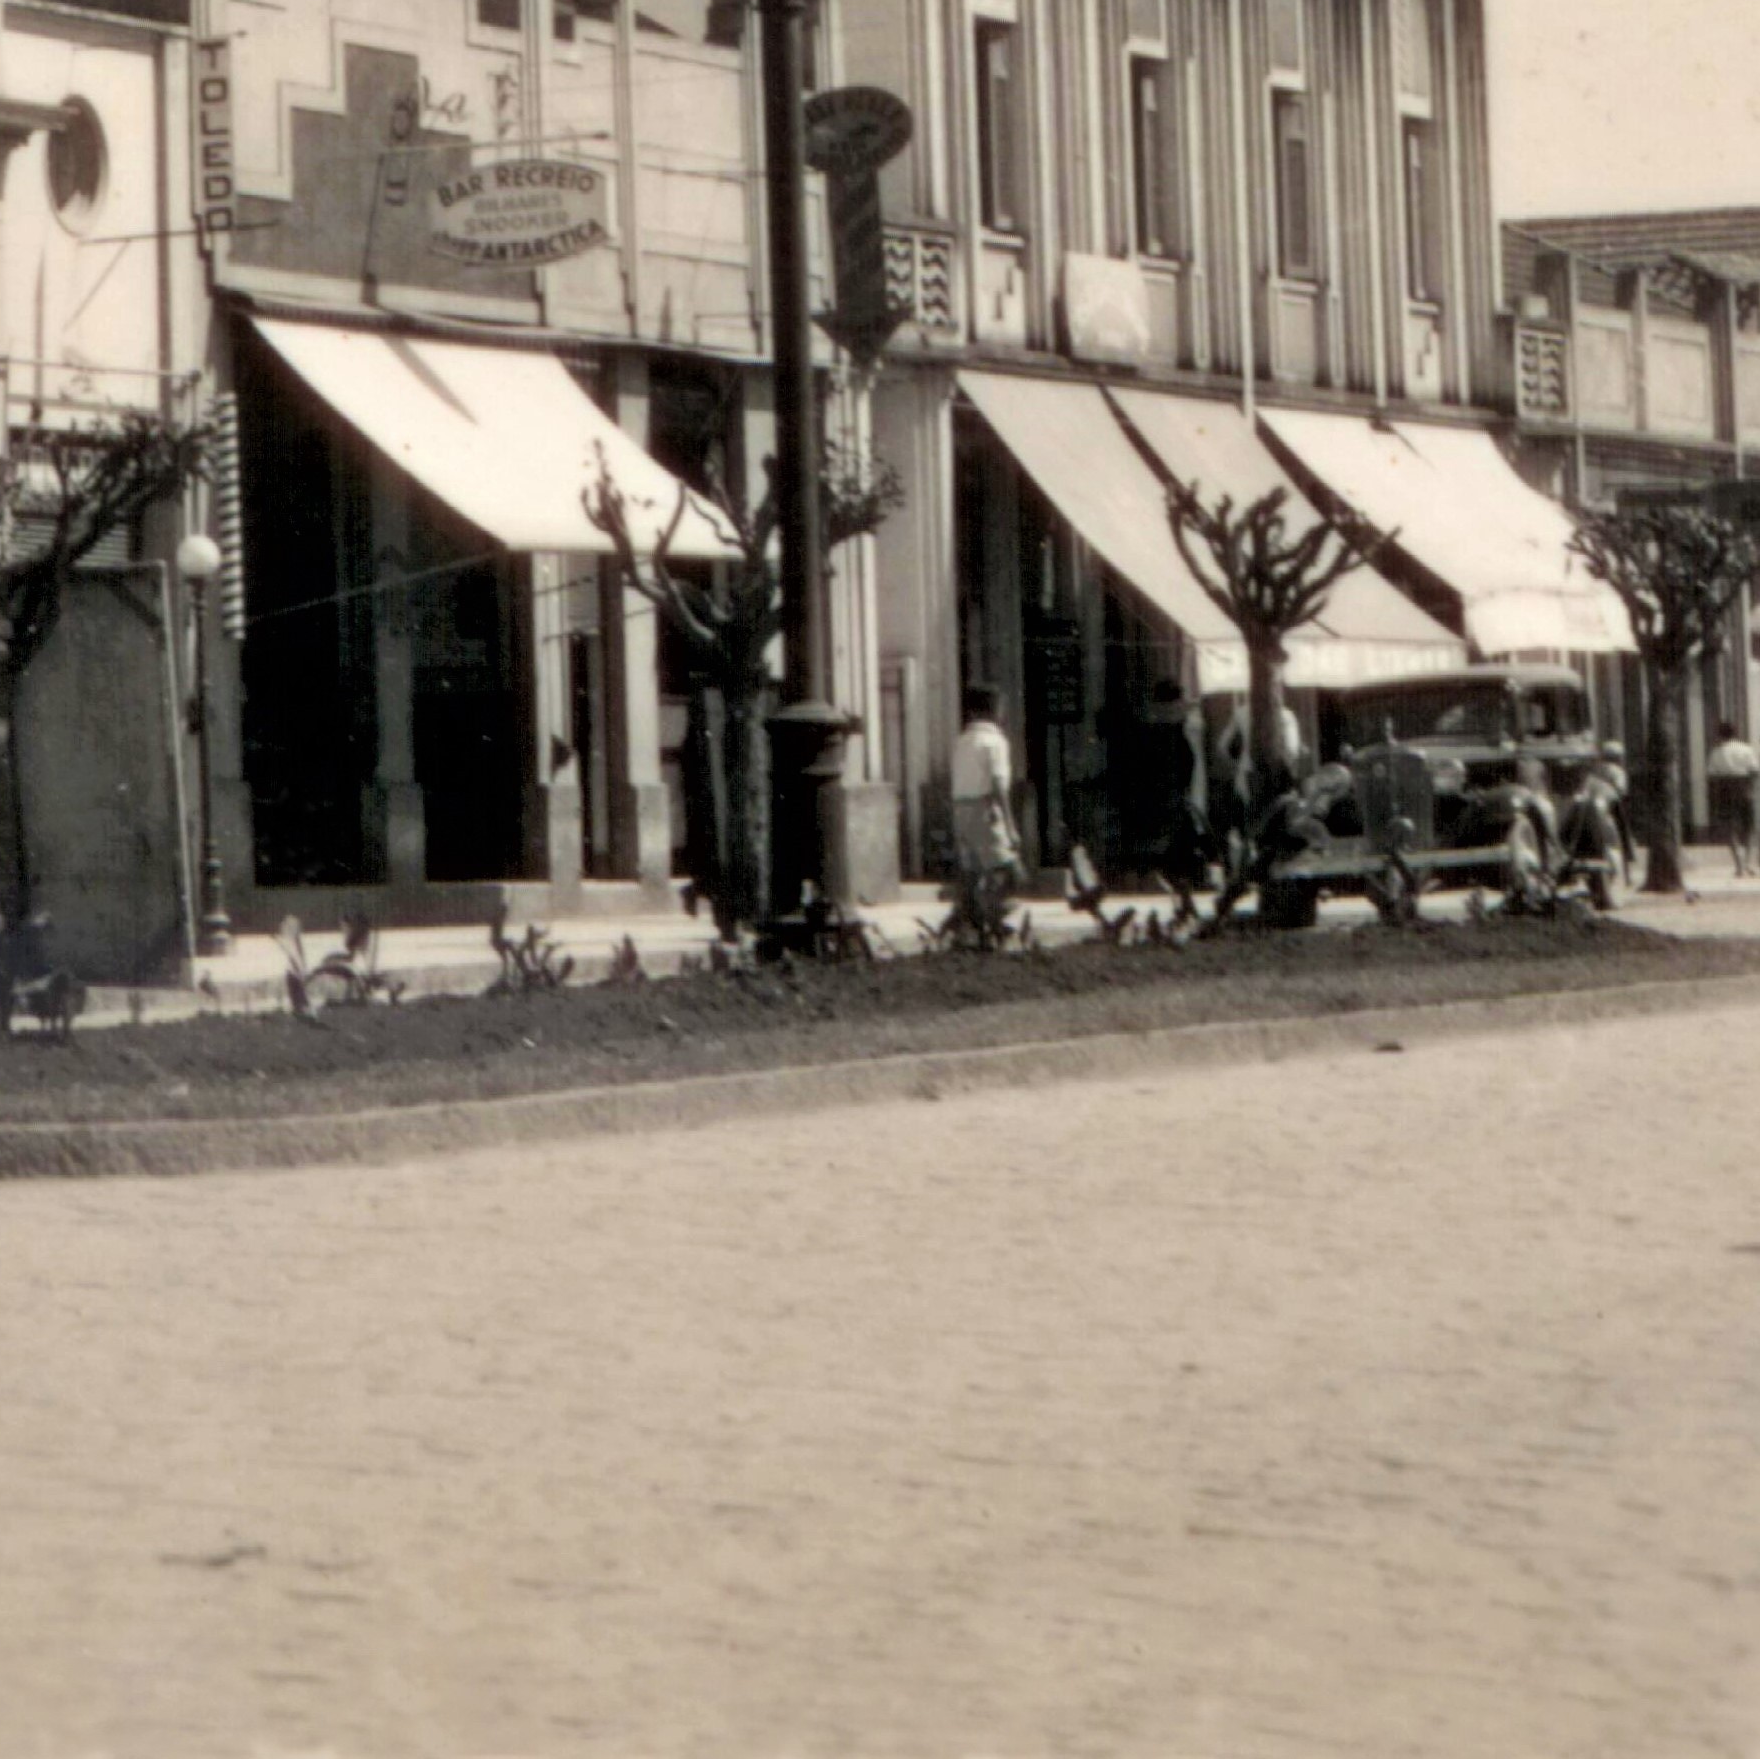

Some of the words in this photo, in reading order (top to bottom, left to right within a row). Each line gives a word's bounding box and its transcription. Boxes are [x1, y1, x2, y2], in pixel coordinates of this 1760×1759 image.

[197, 40, 233, 232] TOLEDO
[436, 174, 484, 209] BAR
[495, 164, 596, 195] RECREIO
[465, 209, 570, 235] SNOOKER
[482, 217, 603, 260] ANTARCTICA
